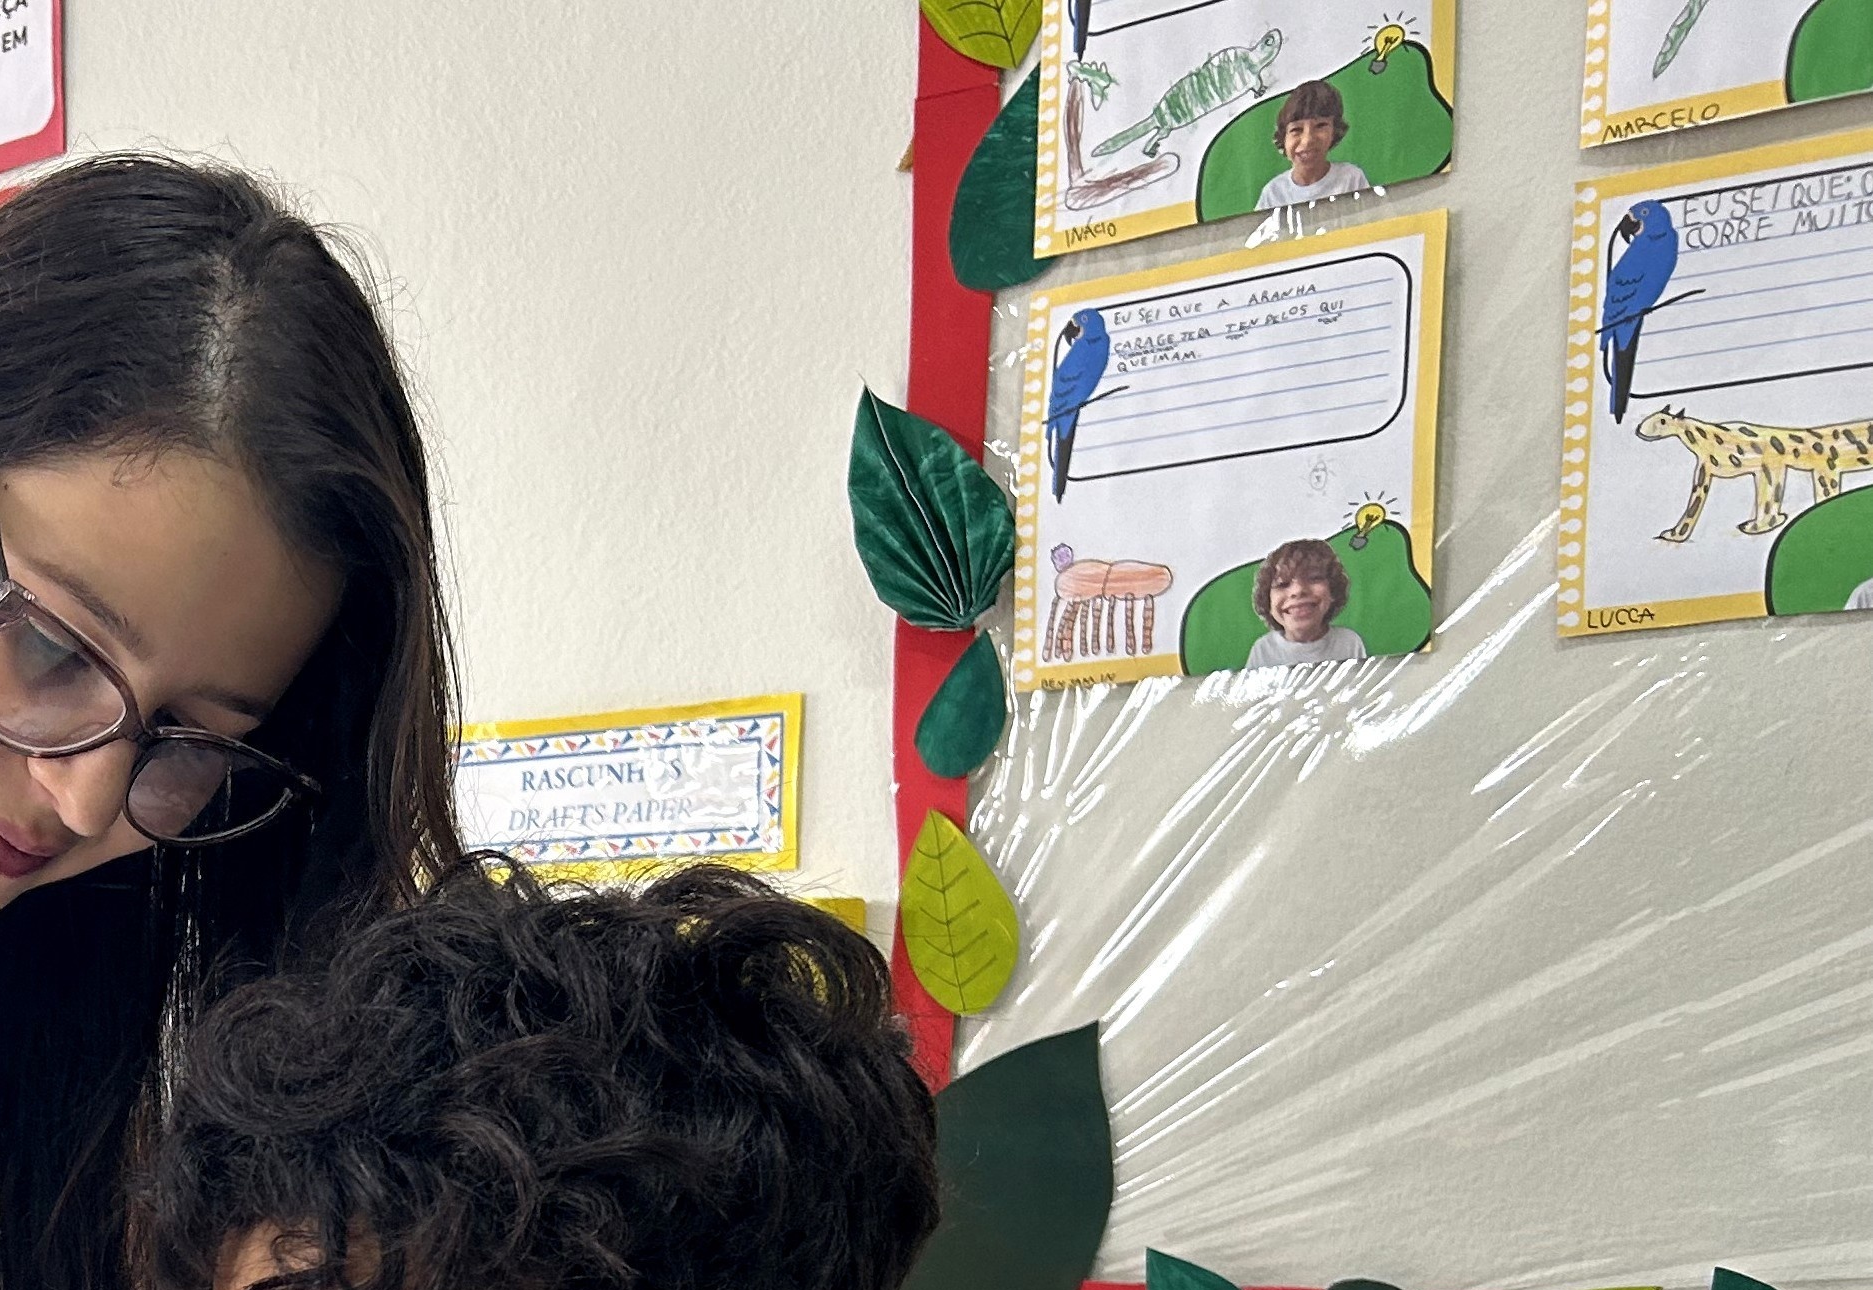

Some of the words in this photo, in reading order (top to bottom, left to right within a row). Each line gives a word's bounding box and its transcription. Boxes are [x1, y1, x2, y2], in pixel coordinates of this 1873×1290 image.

[1, 26, 28, 53] EM
[1601, 102, 1720, 143] MARCELO
[1683, 193, 1722, 227] EU
[1730, 183, 1782, 221] SEI
[1065, 215, 1117, 248] INÁCIO
[1685, 215, 1774, 249] CORRE
[1113, 311, 1131, 326] EU
[1138, 307, 1160, 325] SEI
[1168, 302, 1202, 319] QUE
[1217, 298, 1230, 310] A
[1247, 284, 1317, 307] ARANHA
[1587, 607, 1655, 629] LUCCA
[521, 758, 683, 792] RASCUNHS
[508, 802, 606, 831] DRAFTS
[612, 797, 693, 825] PAPER
